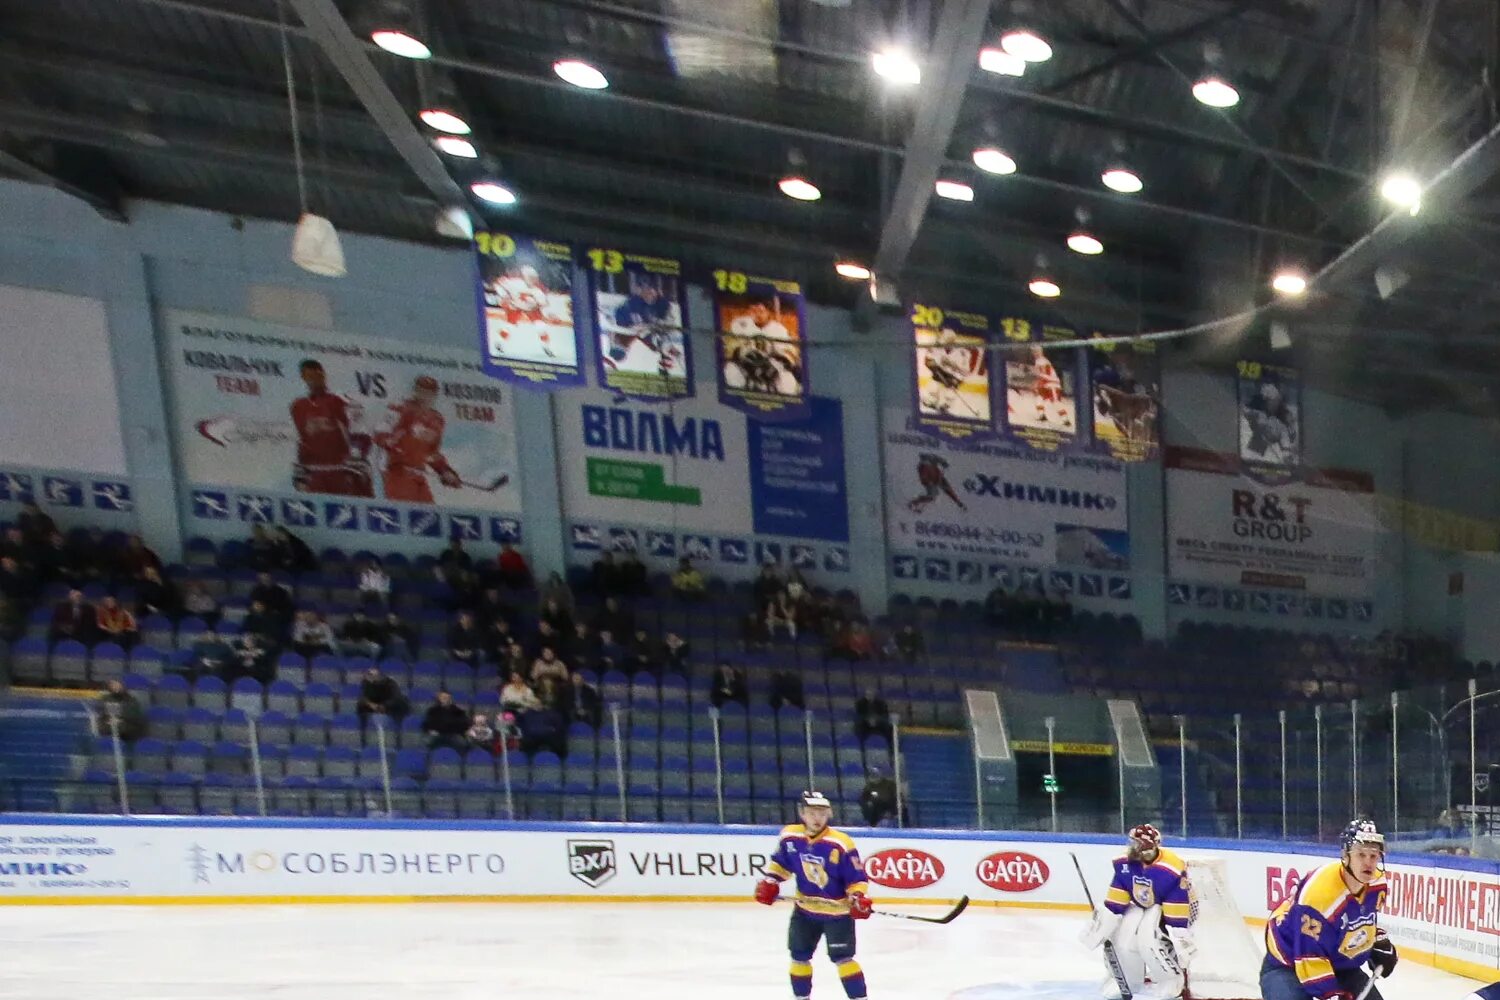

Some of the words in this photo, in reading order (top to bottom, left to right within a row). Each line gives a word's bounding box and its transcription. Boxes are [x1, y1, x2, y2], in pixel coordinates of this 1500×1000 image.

[475, 231, 516, 258] 10
[588, 248, 625, 274] 13
[911, 303, 944, 327] 20
[1001, 317, 1031, 341] 13
[355, 370, 387, 398] VS
[582, 404, 725, 462] ВОЛМА
[1232, 489, 1312, 524] R&T
[1233, 518, 1312, 542] GROUP
[215, 849, 506, 875] МОСОБЛЭНЕРГО
[570, 850, 615, 873] ВХЛ
[630, 851, 768, 877] VHLRU.R
[865, 852, 939, 880] САФА
[978, 855, 1044, 883] САФА
